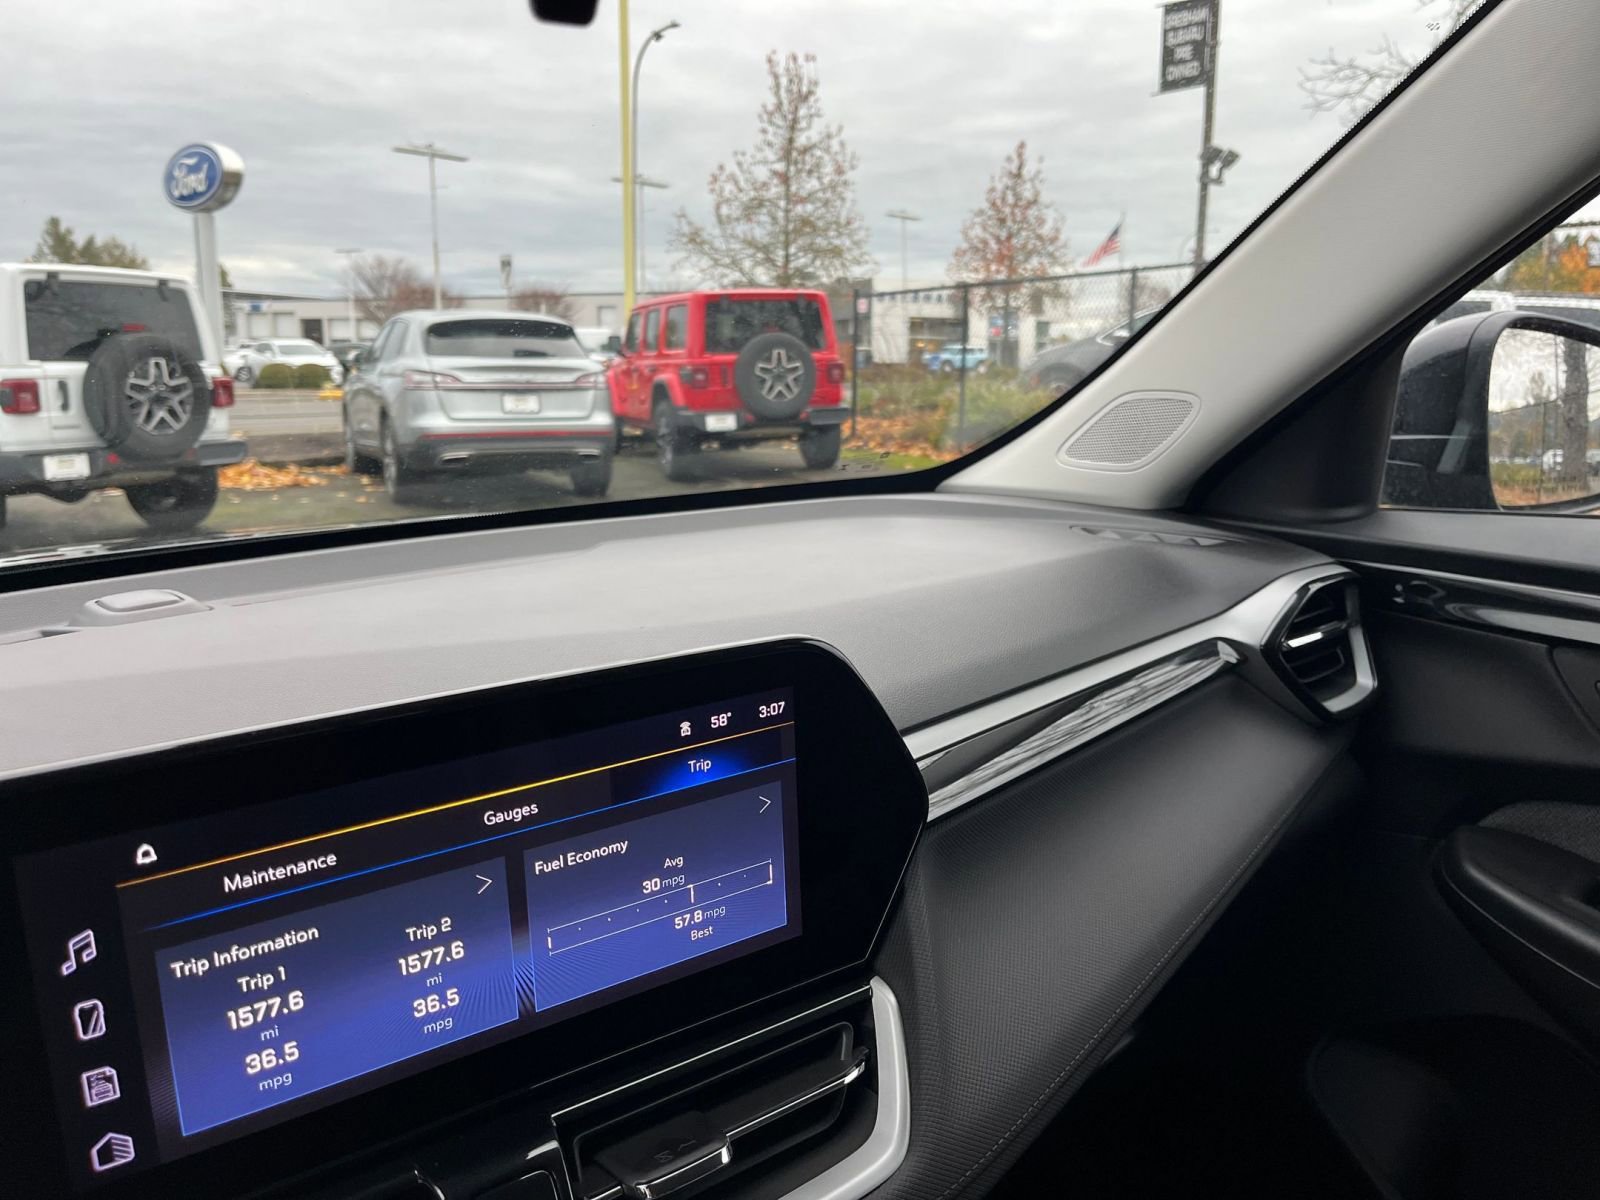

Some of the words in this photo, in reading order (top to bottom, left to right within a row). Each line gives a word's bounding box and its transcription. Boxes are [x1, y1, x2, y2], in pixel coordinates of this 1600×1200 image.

[170, 155, 209, 198] Ford
[758, 701, 786, 718] 3:07
[687, 759, 712, 773] Trip
[483, 803, 539, 827] Gauges
[534, 854, 564, 875] Fuel
[566, 840, 629, 866] Economy
[663, 855, 684, 869] Avg
[222, 852, 338, 893] Maintenance
[642, 877, 661, 894] 30
[662, 873, 685, 888] mpg
[405, 924, 438, 942] Trip
[440, 916, 452, 932] 2
[673, 909, 703, 930] 57.8
[703, 905, 727, 919] mpg
[690, 925, 714, 941] Best
[169, 958, 210, 978] Trip
[213, 926, 320, 967] Information
[398, 940, 465, 976] 1577.6
[237, 972, 275, 992] Trip
[277, 965, 287, 981] 1
[426, 972, 442, 987] mi
[226, 990, 305, 1031] 1577.6
[413, 987, 460, 1018] 36.5
[260, 1024, 280, 1041] mi
[423, 1017, 453, 1034] mpg
[244, 1040, 300, 1075] 36.5
[259, 1072, 293, 1091] mpg
